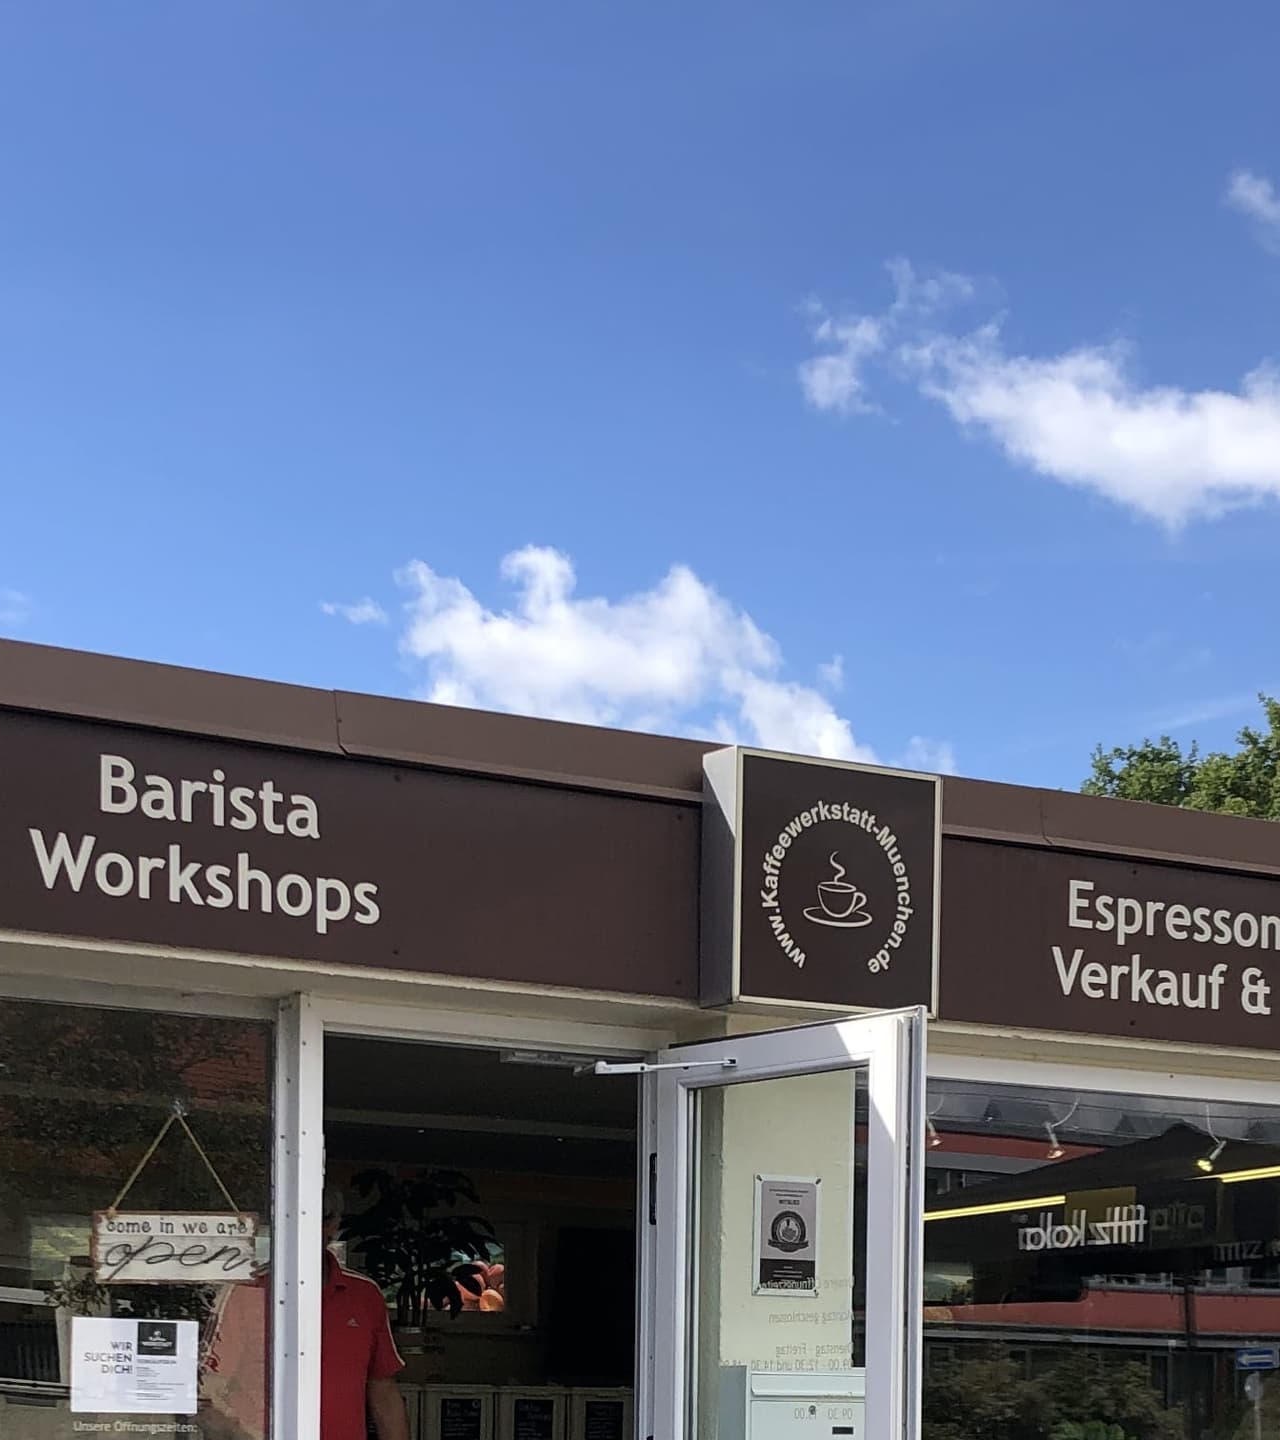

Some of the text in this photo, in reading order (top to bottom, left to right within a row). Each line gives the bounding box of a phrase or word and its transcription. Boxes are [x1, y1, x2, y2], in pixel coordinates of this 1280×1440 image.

[99, 754, 320, 840] Barista
[28, 827, 382, 933] Workshops
[761, 800, 914, 975] www.Kaffeewerkstatt-Muenchen.de
[1053, 945, 1225, 1011] Verkauf
[1241, 972, 1272, 1015] &
[160, 1216, 175, 1234] in
[182, 1221, 208, 1234] we
[217, 1220, 248, 1234] are
[105, 1234, 251, 1282] open
[83, 1352, 133, 1363] SUCHEN
[110, 1341, 133, 1352] WIR
